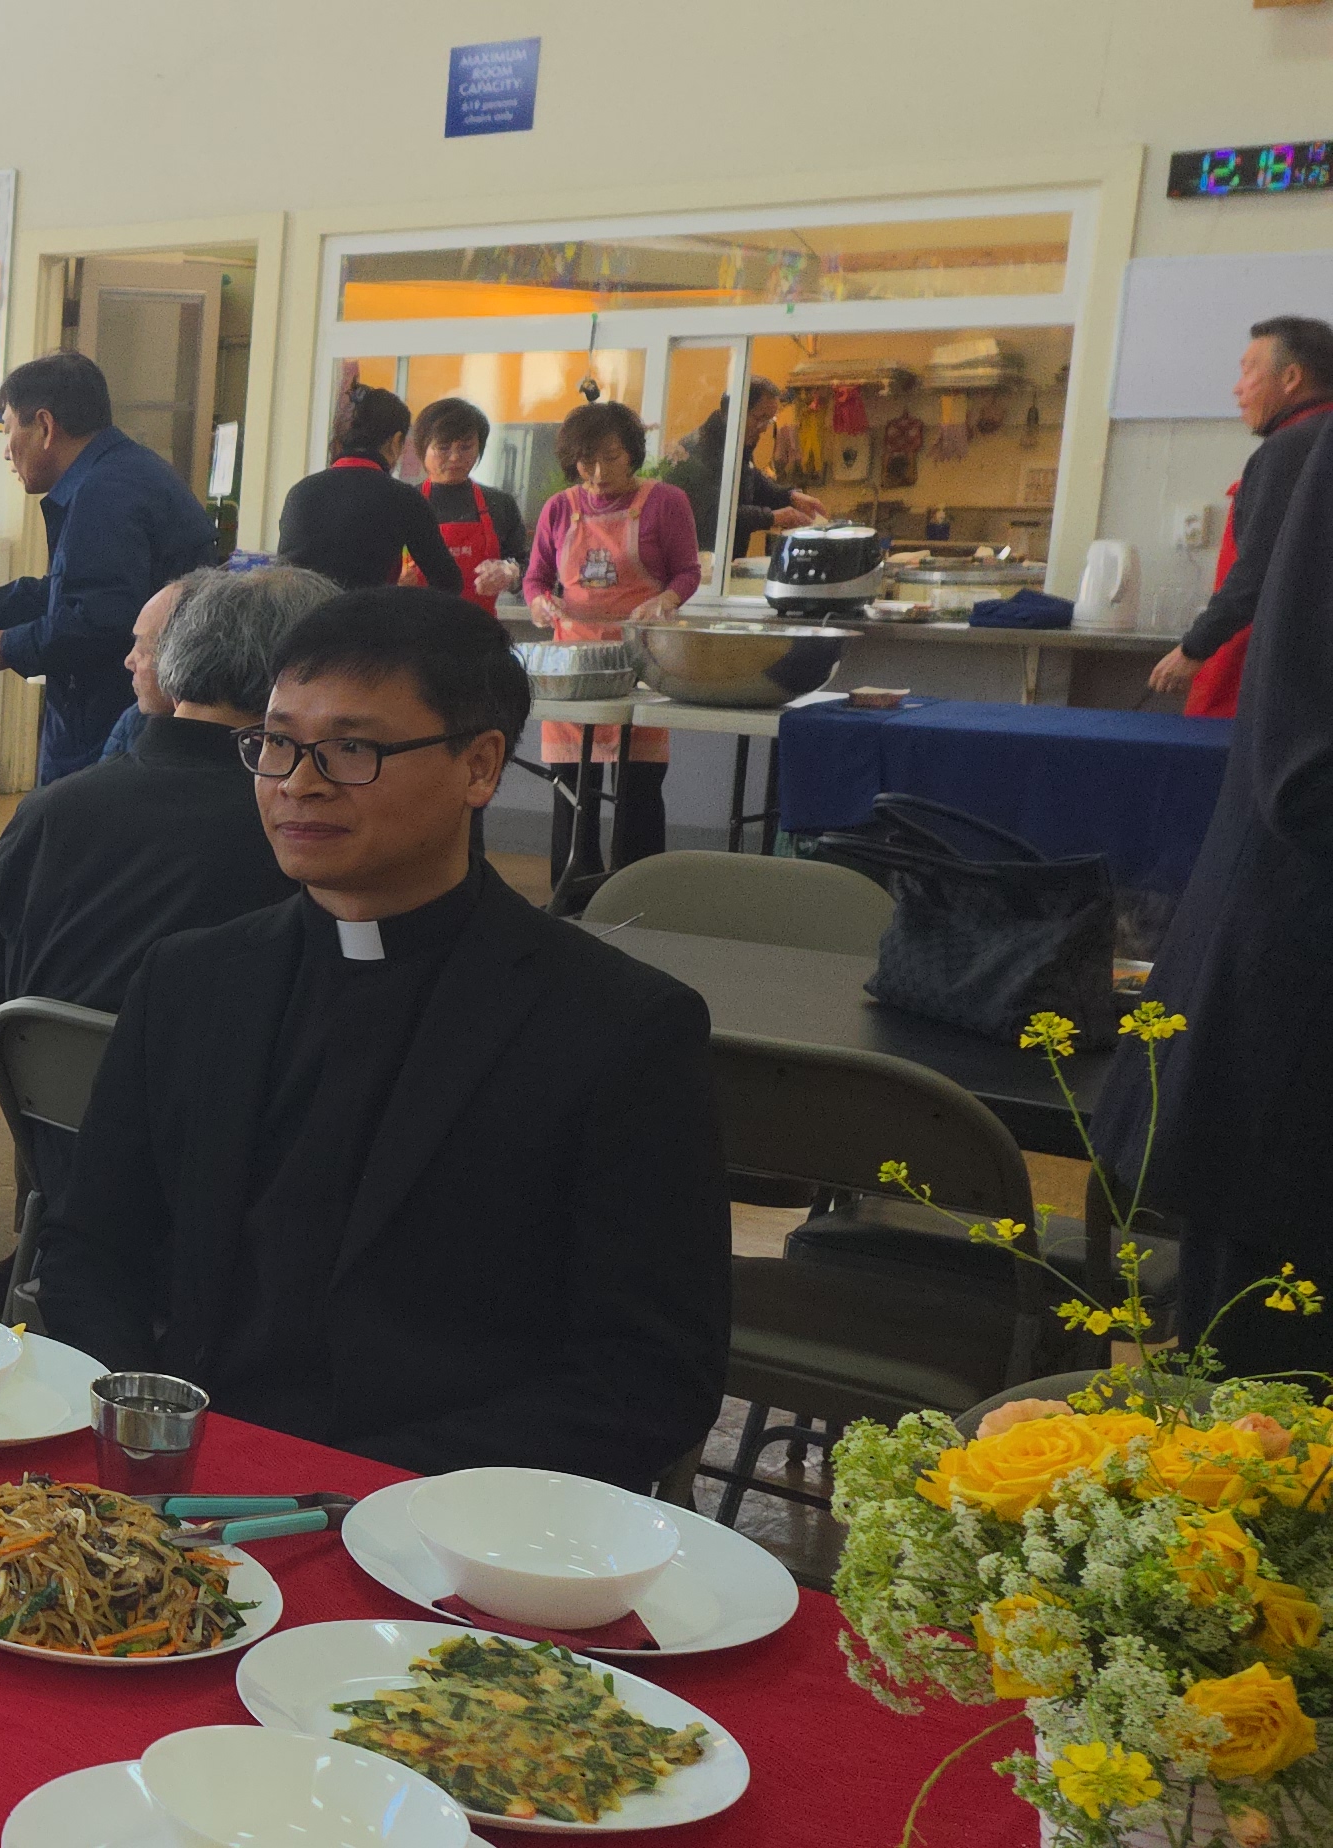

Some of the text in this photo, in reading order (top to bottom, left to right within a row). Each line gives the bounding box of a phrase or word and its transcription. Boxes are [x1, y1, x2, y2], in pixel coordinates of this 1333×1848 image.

[459, 48, 527, 68] MAXIMUM
[473, 65, 513, 80] ROOM
[458, 77, 523, 96] CAPACITY
